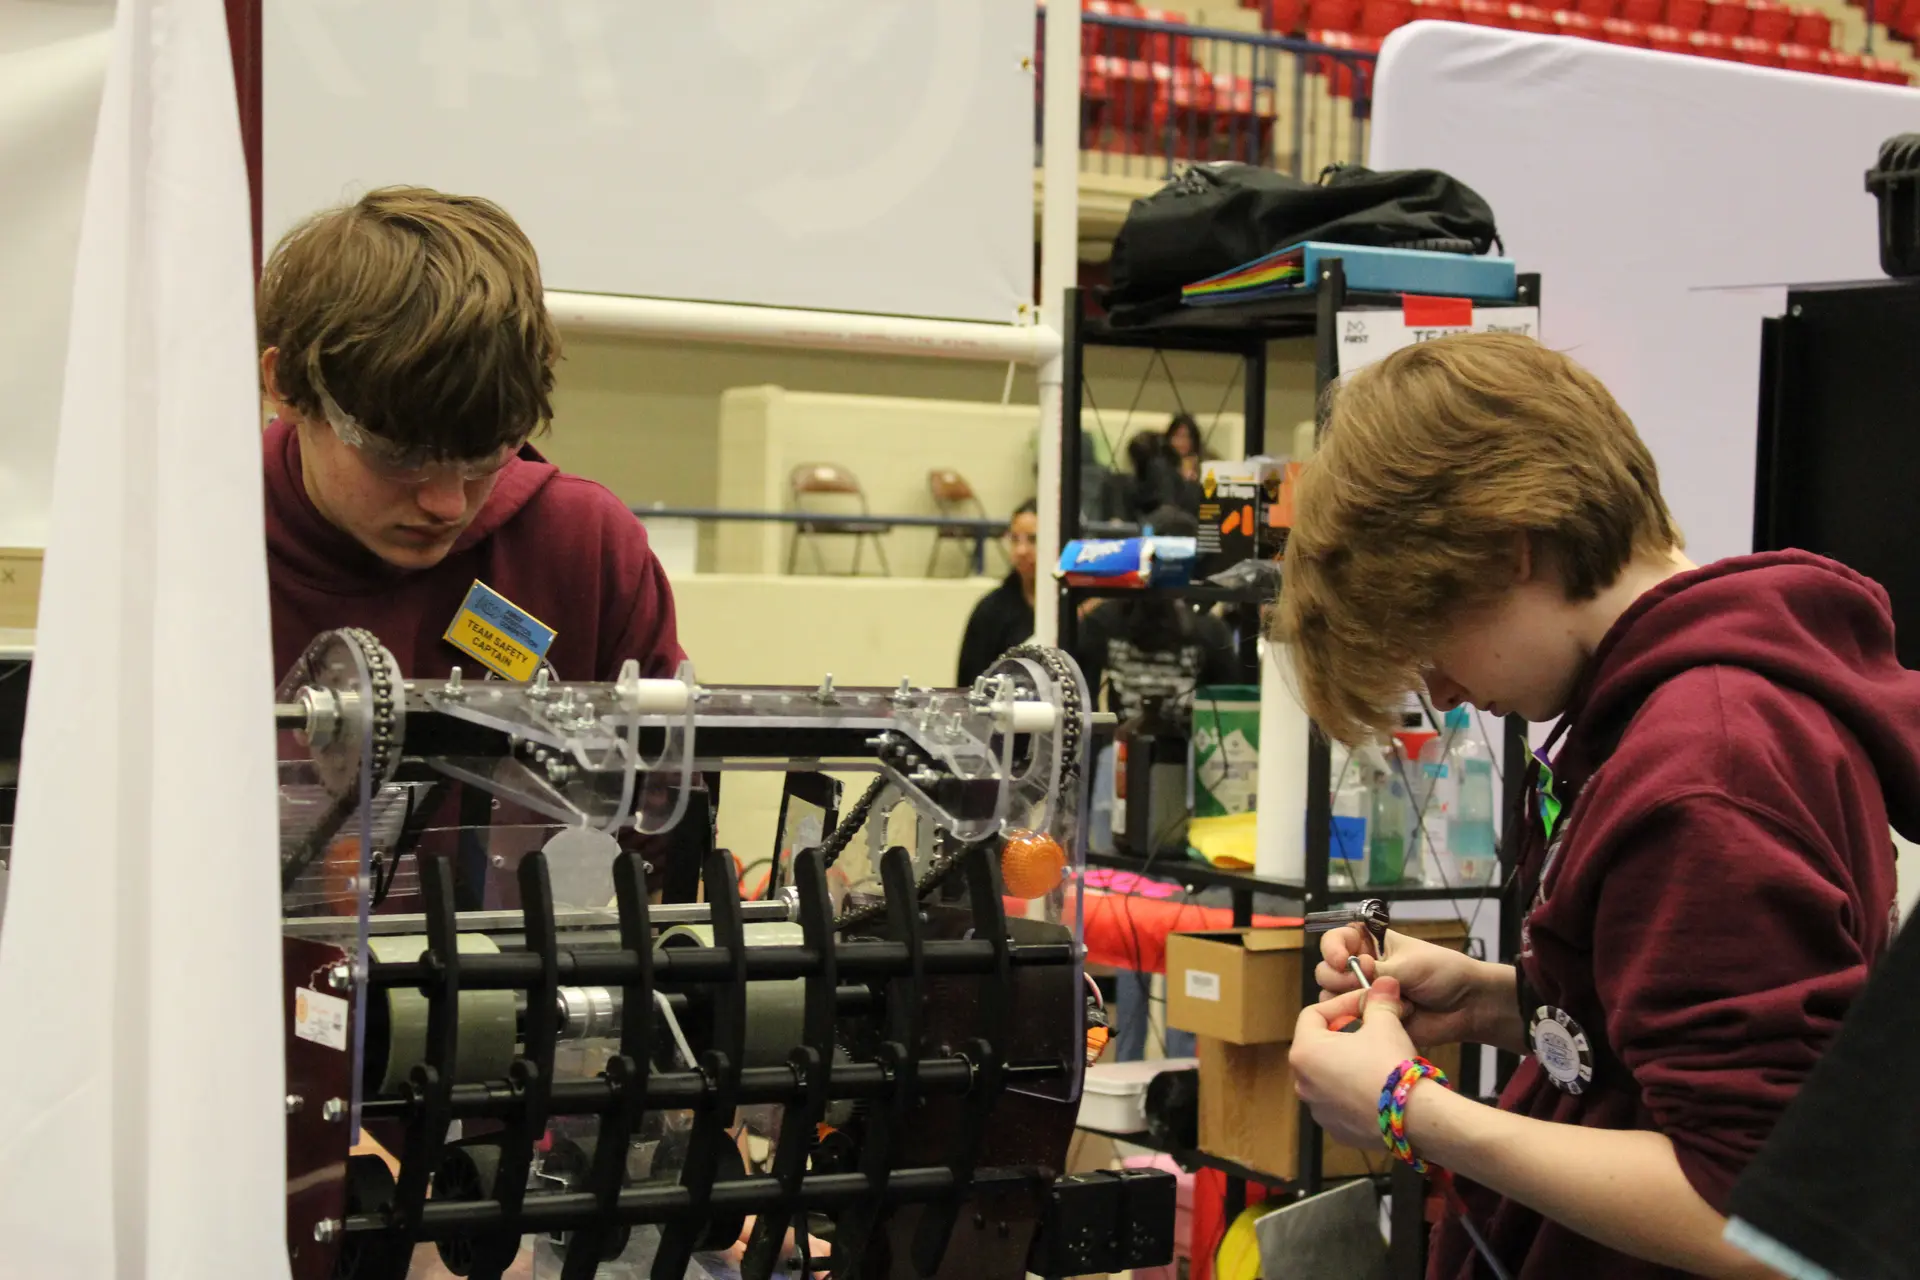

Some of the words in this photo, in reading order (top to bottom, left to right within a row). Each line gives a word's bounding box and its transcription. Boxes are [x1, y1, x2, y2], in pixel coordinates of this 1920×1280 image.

[1344, 335, 1369, 343] FIRST
[467, 619, 493, 641] TEAM
[493, 637, 529, 664] SAFETY
[471, 637, 513, 667] CAPTAIN
